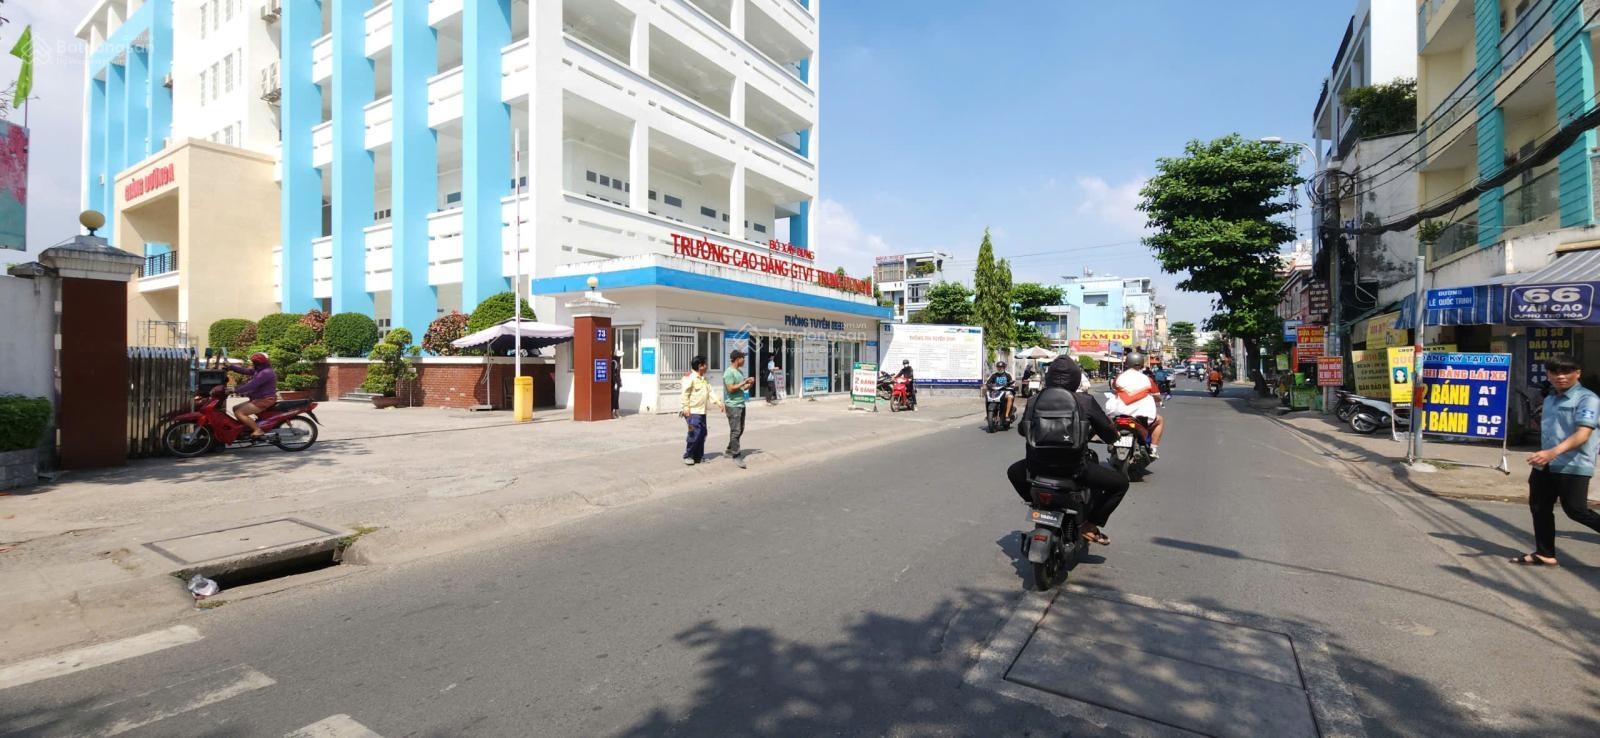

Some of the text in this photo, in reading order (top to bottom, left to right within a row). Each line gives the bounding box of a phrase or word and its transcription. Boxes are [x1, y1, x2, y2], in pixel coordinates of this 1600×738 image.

[671, 233, 730, 264] TRƯỜNG
[733, 249, 758, 270] CAO
[790, 263, 815, 282] GTVT
[1522, 287, 1581, 303] 66
[1551, 303, 1583, 312] CAO
[784, 314, 809, 328] PHÒNG
[597, 329, 606, 338] 73
[1422, 354, 1446, 362] ĂNG
[1466, 354, 1483, 364] TẠI
[1484, 355, 1506, 364] ĐÂY
[1531, 363, 1538, 372] 2
[1423, 365, 1507, 381] HI BẰNG LÁI XE
[1531, 375, 1538, 384] 4
[1430, 380, 1471, 406] BÁNH
[1478, 385, 1497, 395] A1
[1477, 397, 1489, 406] A
[1428, 407, 1469, 433] BÁNH
